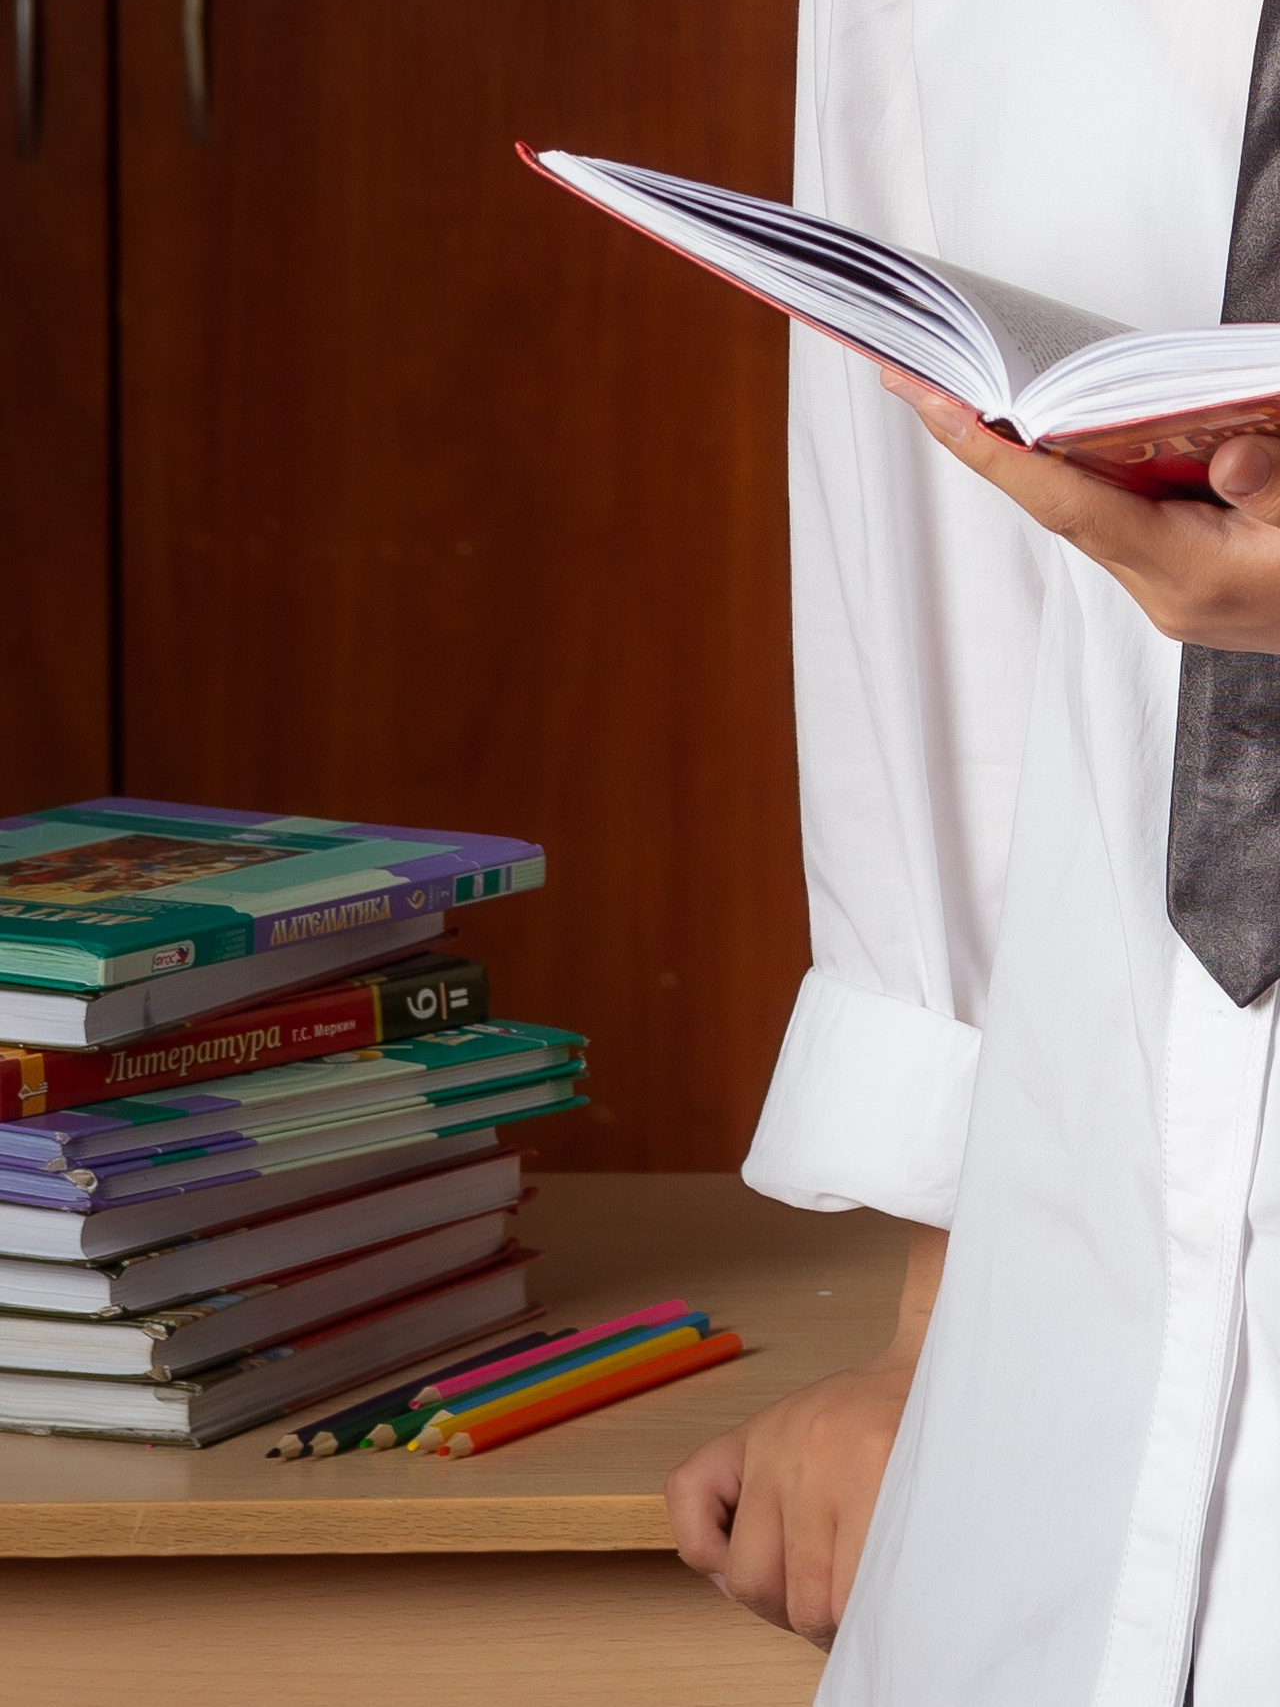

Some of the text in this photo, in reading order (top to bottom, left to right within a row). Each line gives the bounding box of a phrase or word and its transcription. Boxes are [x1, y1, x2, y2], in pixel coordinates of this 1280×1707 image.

[270, 895, 392, 947] МАТЕМАТИКА
[406, 988, 438, 1019] 6
[105, 1018, 357, 1085] Литература Г.С. Меркин
